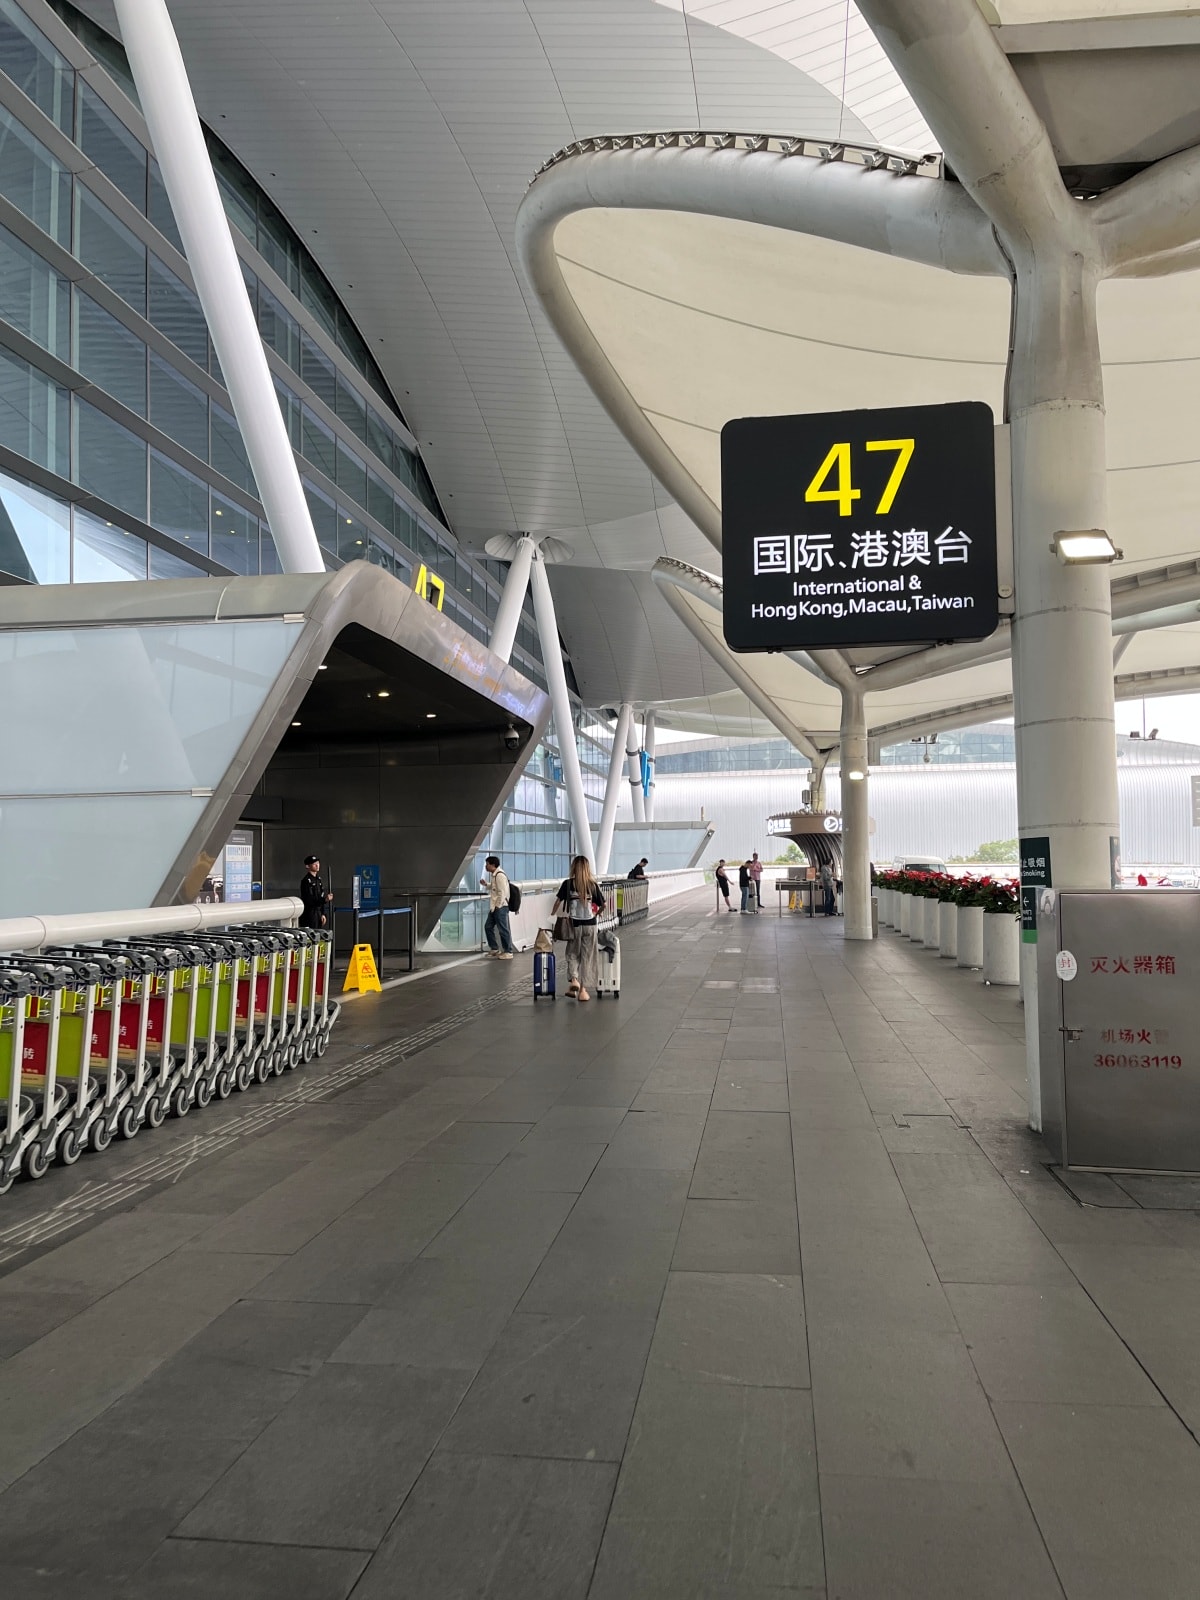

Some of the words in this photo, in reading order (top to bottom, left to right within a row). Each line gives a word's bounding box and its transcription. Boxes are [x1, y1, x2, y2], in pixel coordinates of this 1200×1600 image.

[805, 438, 915, 517] 47
[753, 526, 973, 576] 国际、港澳台
[793, 576, 904, 597] International
[908, 575, 922, 590] &
[1020, 857, 1046, 868] 止吸烟
[1022, 869, 1046, 878] Smoking
[1090, 955, 1176, 974] 灭火器箱
[1094, 1054, 1182, 1069] 36063119
